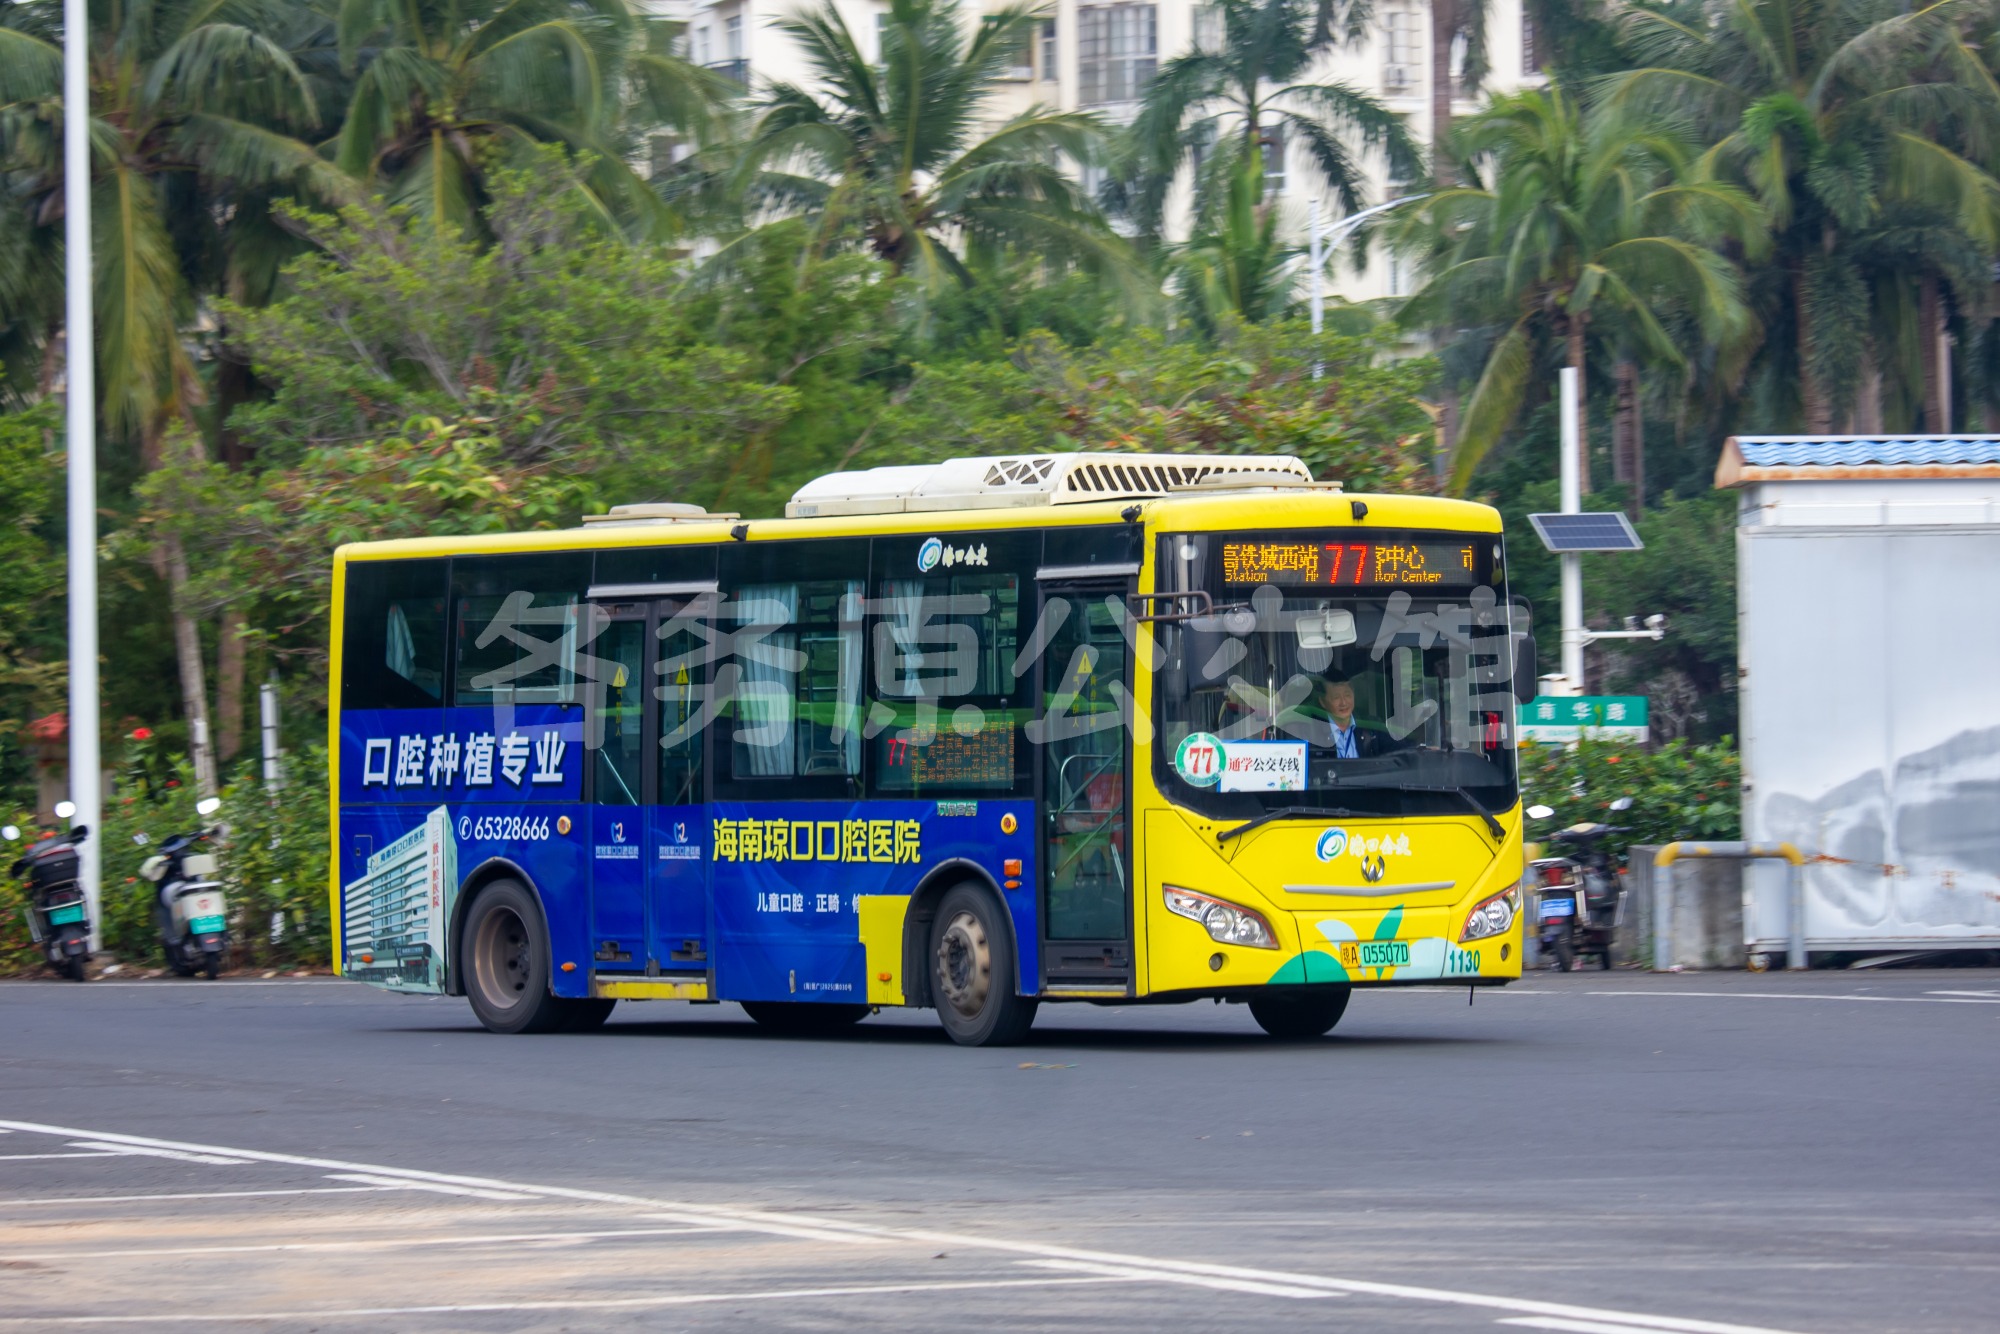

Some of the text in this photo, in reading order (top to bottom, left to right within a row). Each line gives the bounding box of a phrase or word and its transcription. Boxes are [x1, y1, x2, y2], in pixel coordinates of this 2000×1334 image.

[1223, 544, 1318, 571] 高铁城西站
[1325, 543, 1368, 585] 77
[1225, 569, 1268, 582] Station
[1401, 570, 1442, 583] Center
[1536, 701, 1627, 720] 南华路
[363, 731, 566, 787] 口腔种植专业
[887, 738, 907, 767] 77
[1189, 747, 1214, 775] 77
[1228, 757, 1300, 773] 通学公交专线
[474, 816, 550, 841] 65328666
[713, 818, 921, 864] 海南琼口口腔医院
[1363, 943, 1409, 965] 05507D
[1449, 950, 1481, 973] 1130
